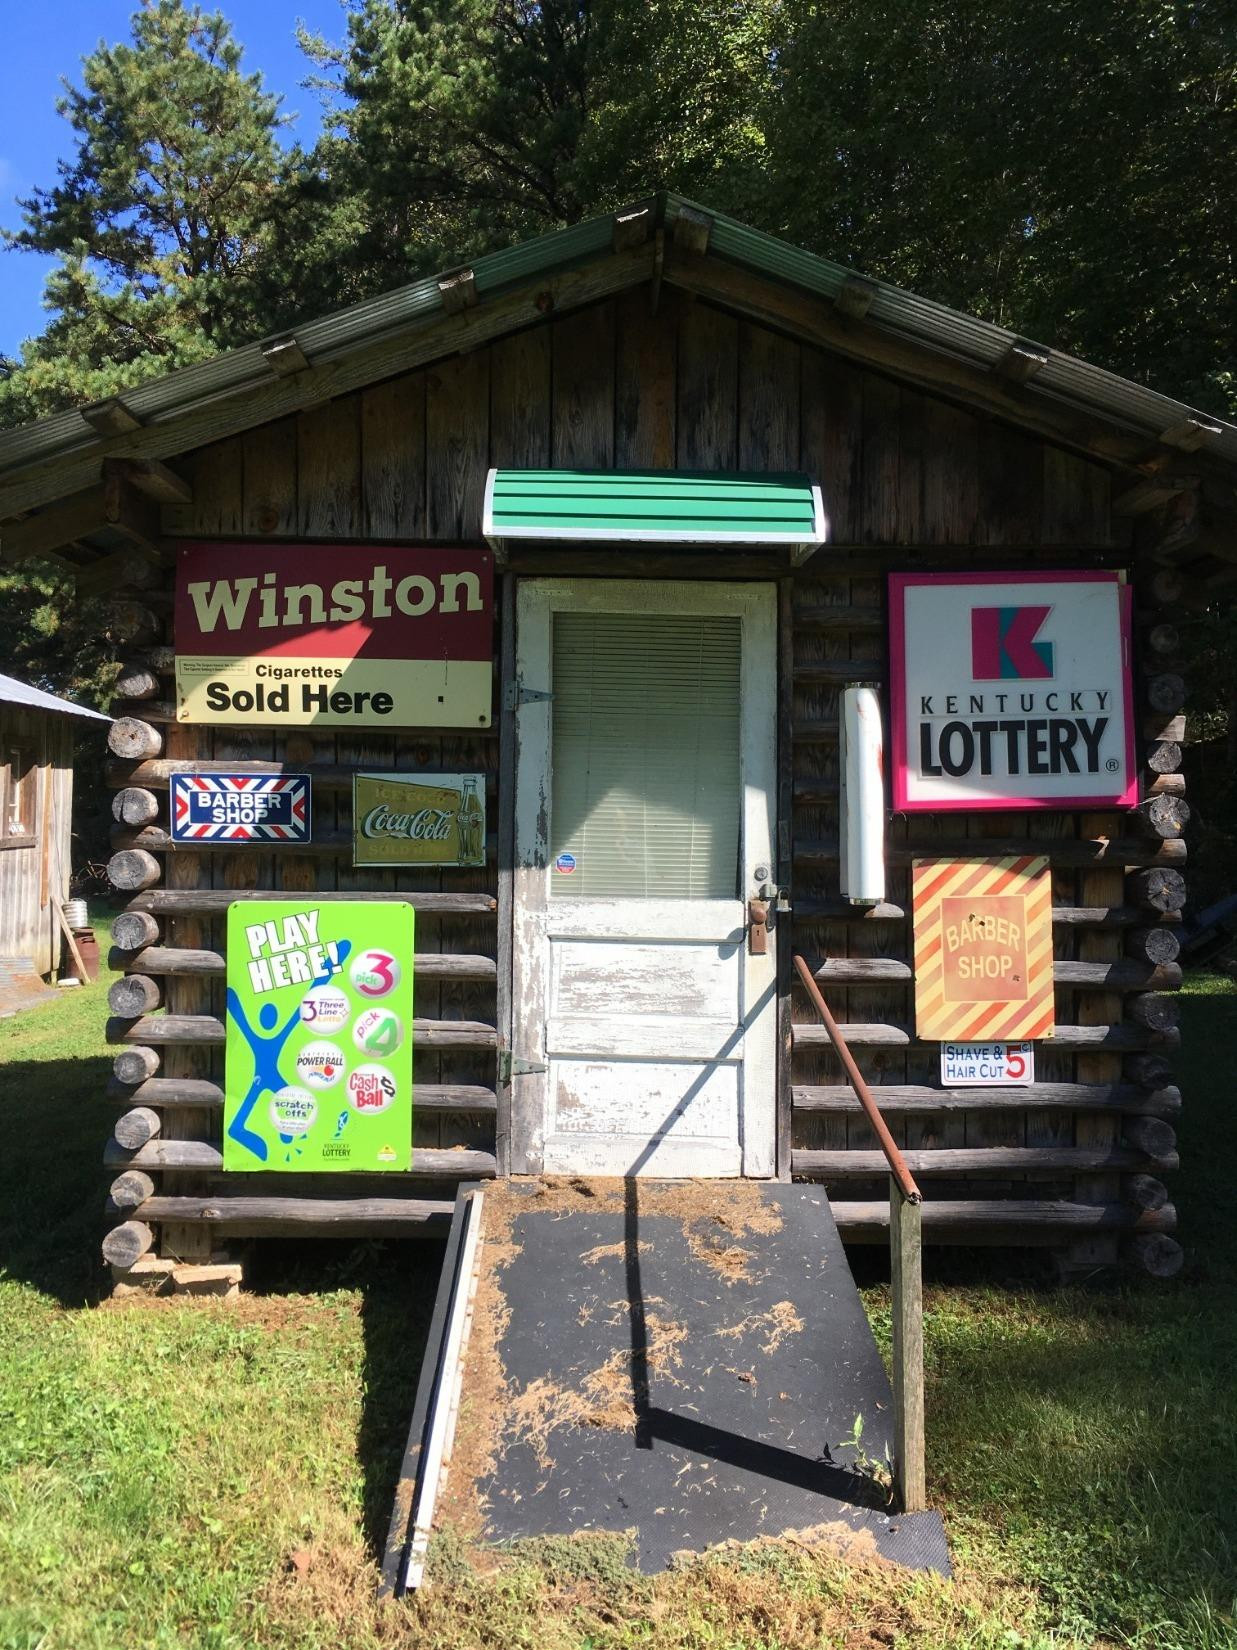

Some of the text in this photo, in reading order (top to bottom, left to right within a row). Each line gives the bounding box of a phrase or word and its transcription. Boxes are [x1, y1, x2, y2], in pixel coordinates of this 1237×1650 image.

[187, 565, 484, 633] Winston
[255, 664, 343, 681] Cigarettes
[206, 682, 394, 714] Sold Here
[920, 691, 1110, 715] KENTUCKY
[919, 717, 1110, 778] LOTTERY
[198, 792, 282, 809] BARBER
[212, 808, 268, 824] SHOP
[364, 804, 456, 840] Coca-Cola
[244, 909, 320, 960] PLAY
[945, 915, 1020, 953] BARBER
[247, 940, 344, 994] HERE!
[359, 953, 394, 996] 3
[958, 955, 1013, 979] SHOP
[302, 1000, 317, 1022] 3
[356, 1011, 381, 1039] pick
[365, 1017, 397, 1057] 4
[946, 1045, 1003, 1061] SHAVE &
[349, 1072, 379, 1091] Cash
[947, 1063, 1004, 1078] HAIR CUT
[274, 1100, 314, 1110] scratch
[355, 1089, 383, 1108] Ball
[323, 1149, 350, 1157] LOTTERY
